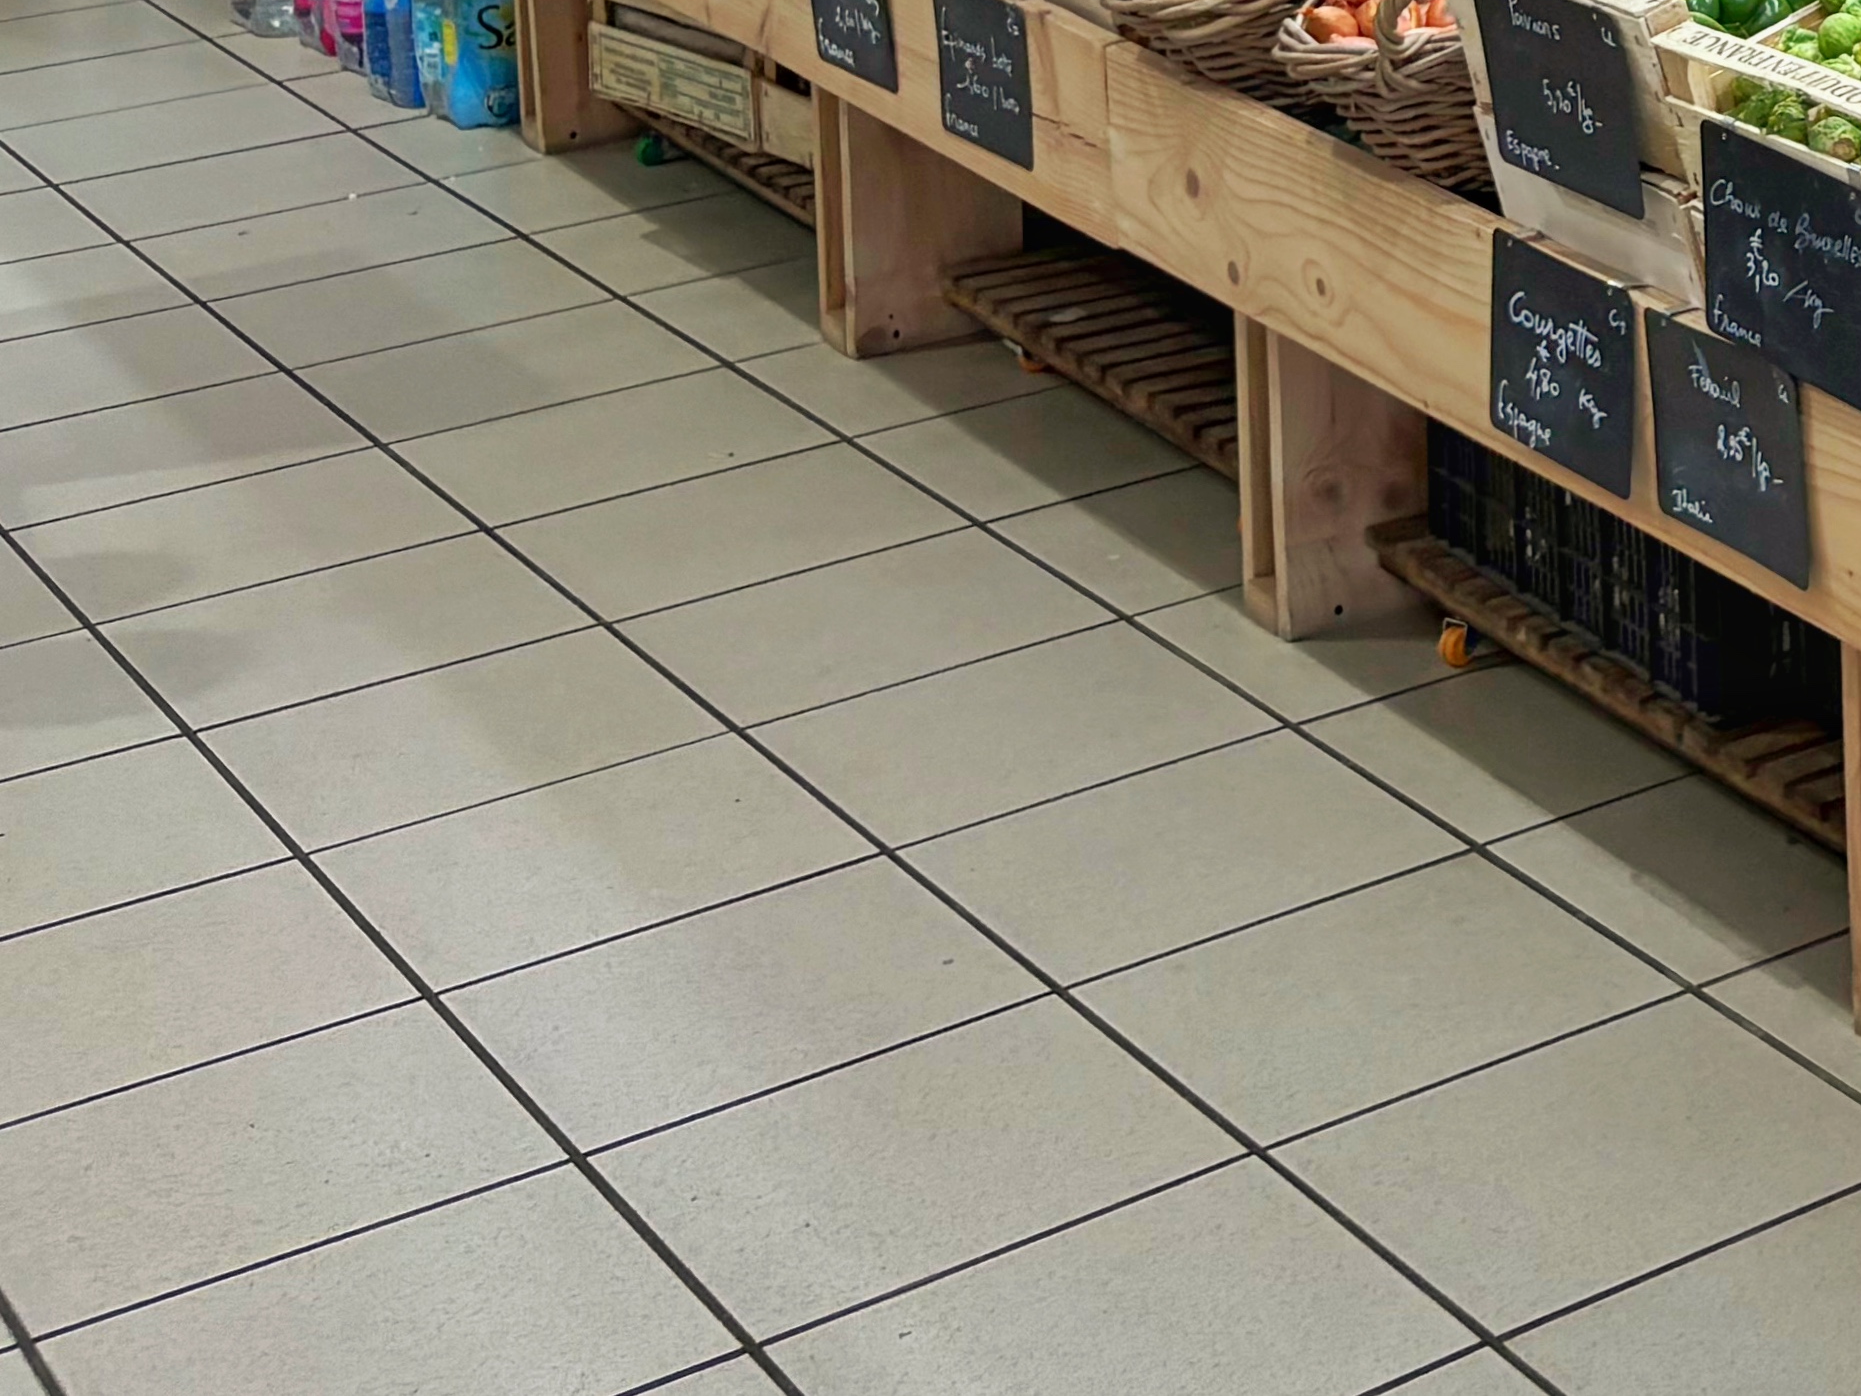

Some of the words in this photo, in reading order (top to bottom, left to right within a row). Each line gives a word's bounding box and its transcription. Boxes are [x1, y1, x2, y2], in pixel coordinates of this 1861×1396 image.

[1682, 29, 1779, 75] FRANCE
[1768, 211, 1788, 234] de
[1746, 252, 1780, 294] 3,20
[1508, 291, 1603, 370] Courgettes
[1713, 294, 1762, 349] France
